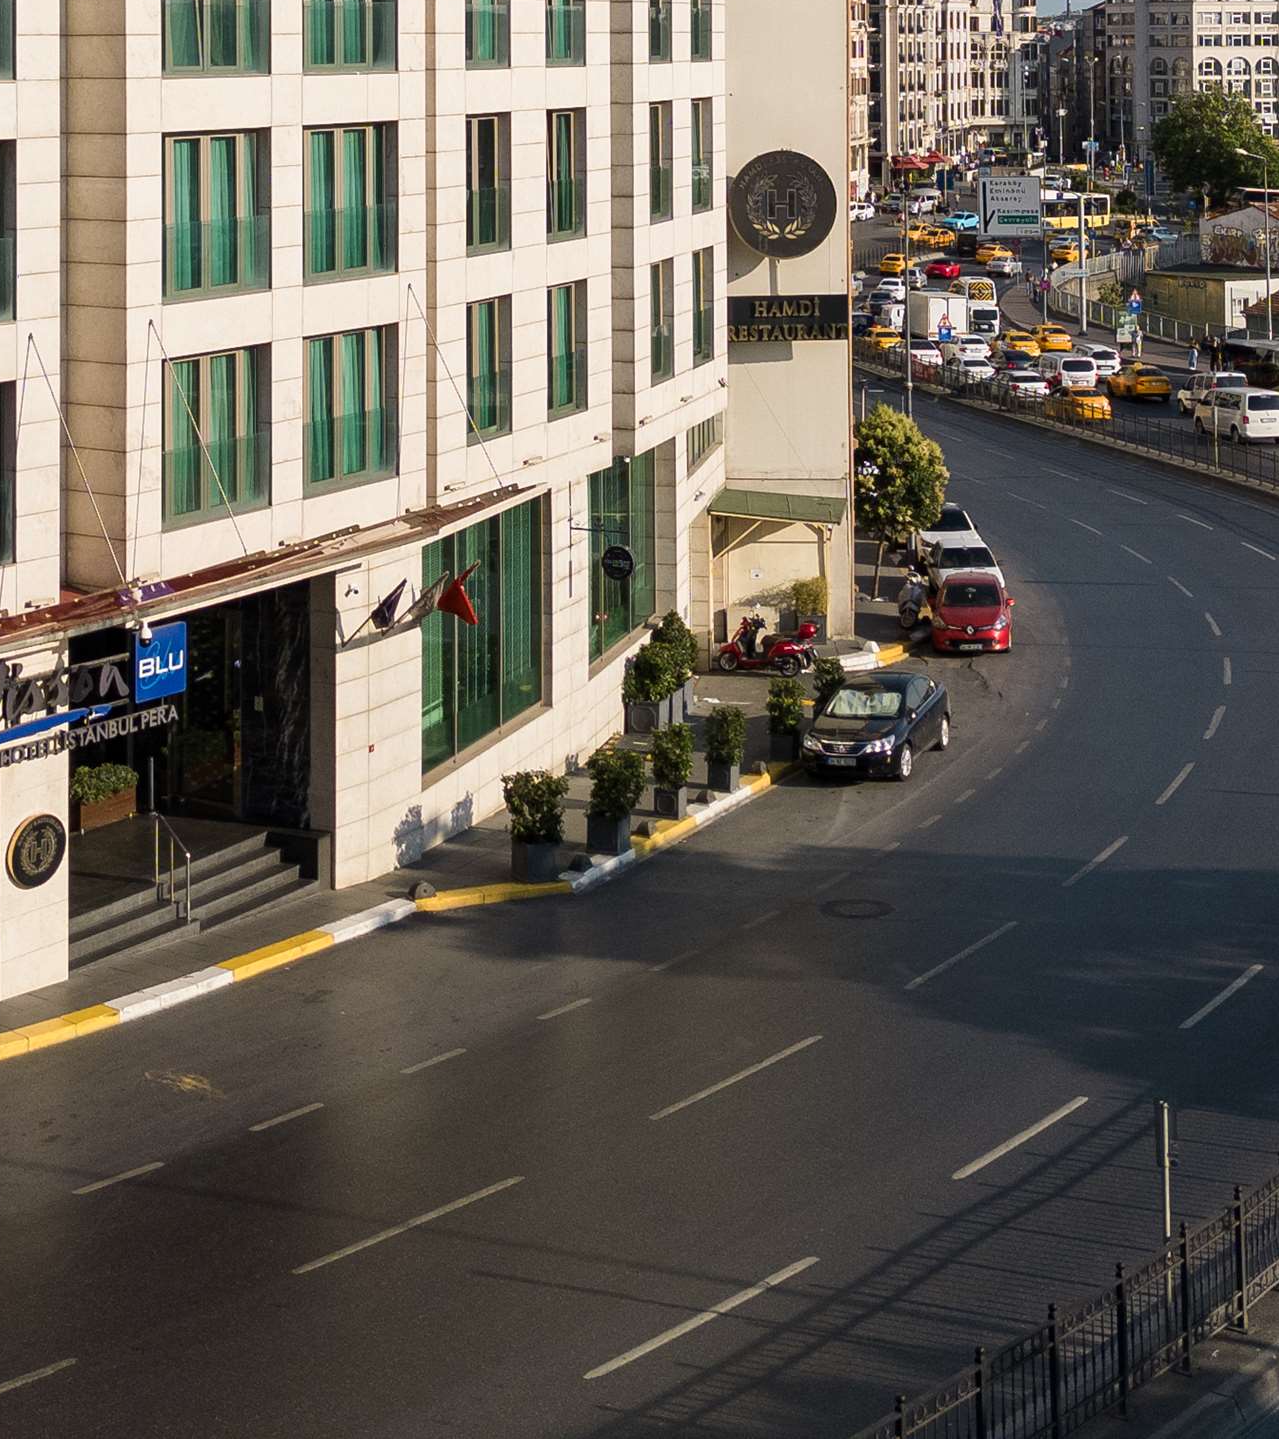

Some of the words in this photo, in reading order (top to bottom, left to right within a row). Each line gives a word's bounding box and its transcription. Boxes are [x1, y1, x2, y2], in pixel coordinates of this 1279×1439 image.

[766, 188, 797, 219] H
[728, 322, 848, 342] RESTAURANT
[138, 649, 184, 679] BLU
[141, 704, 179, 730] PERA
